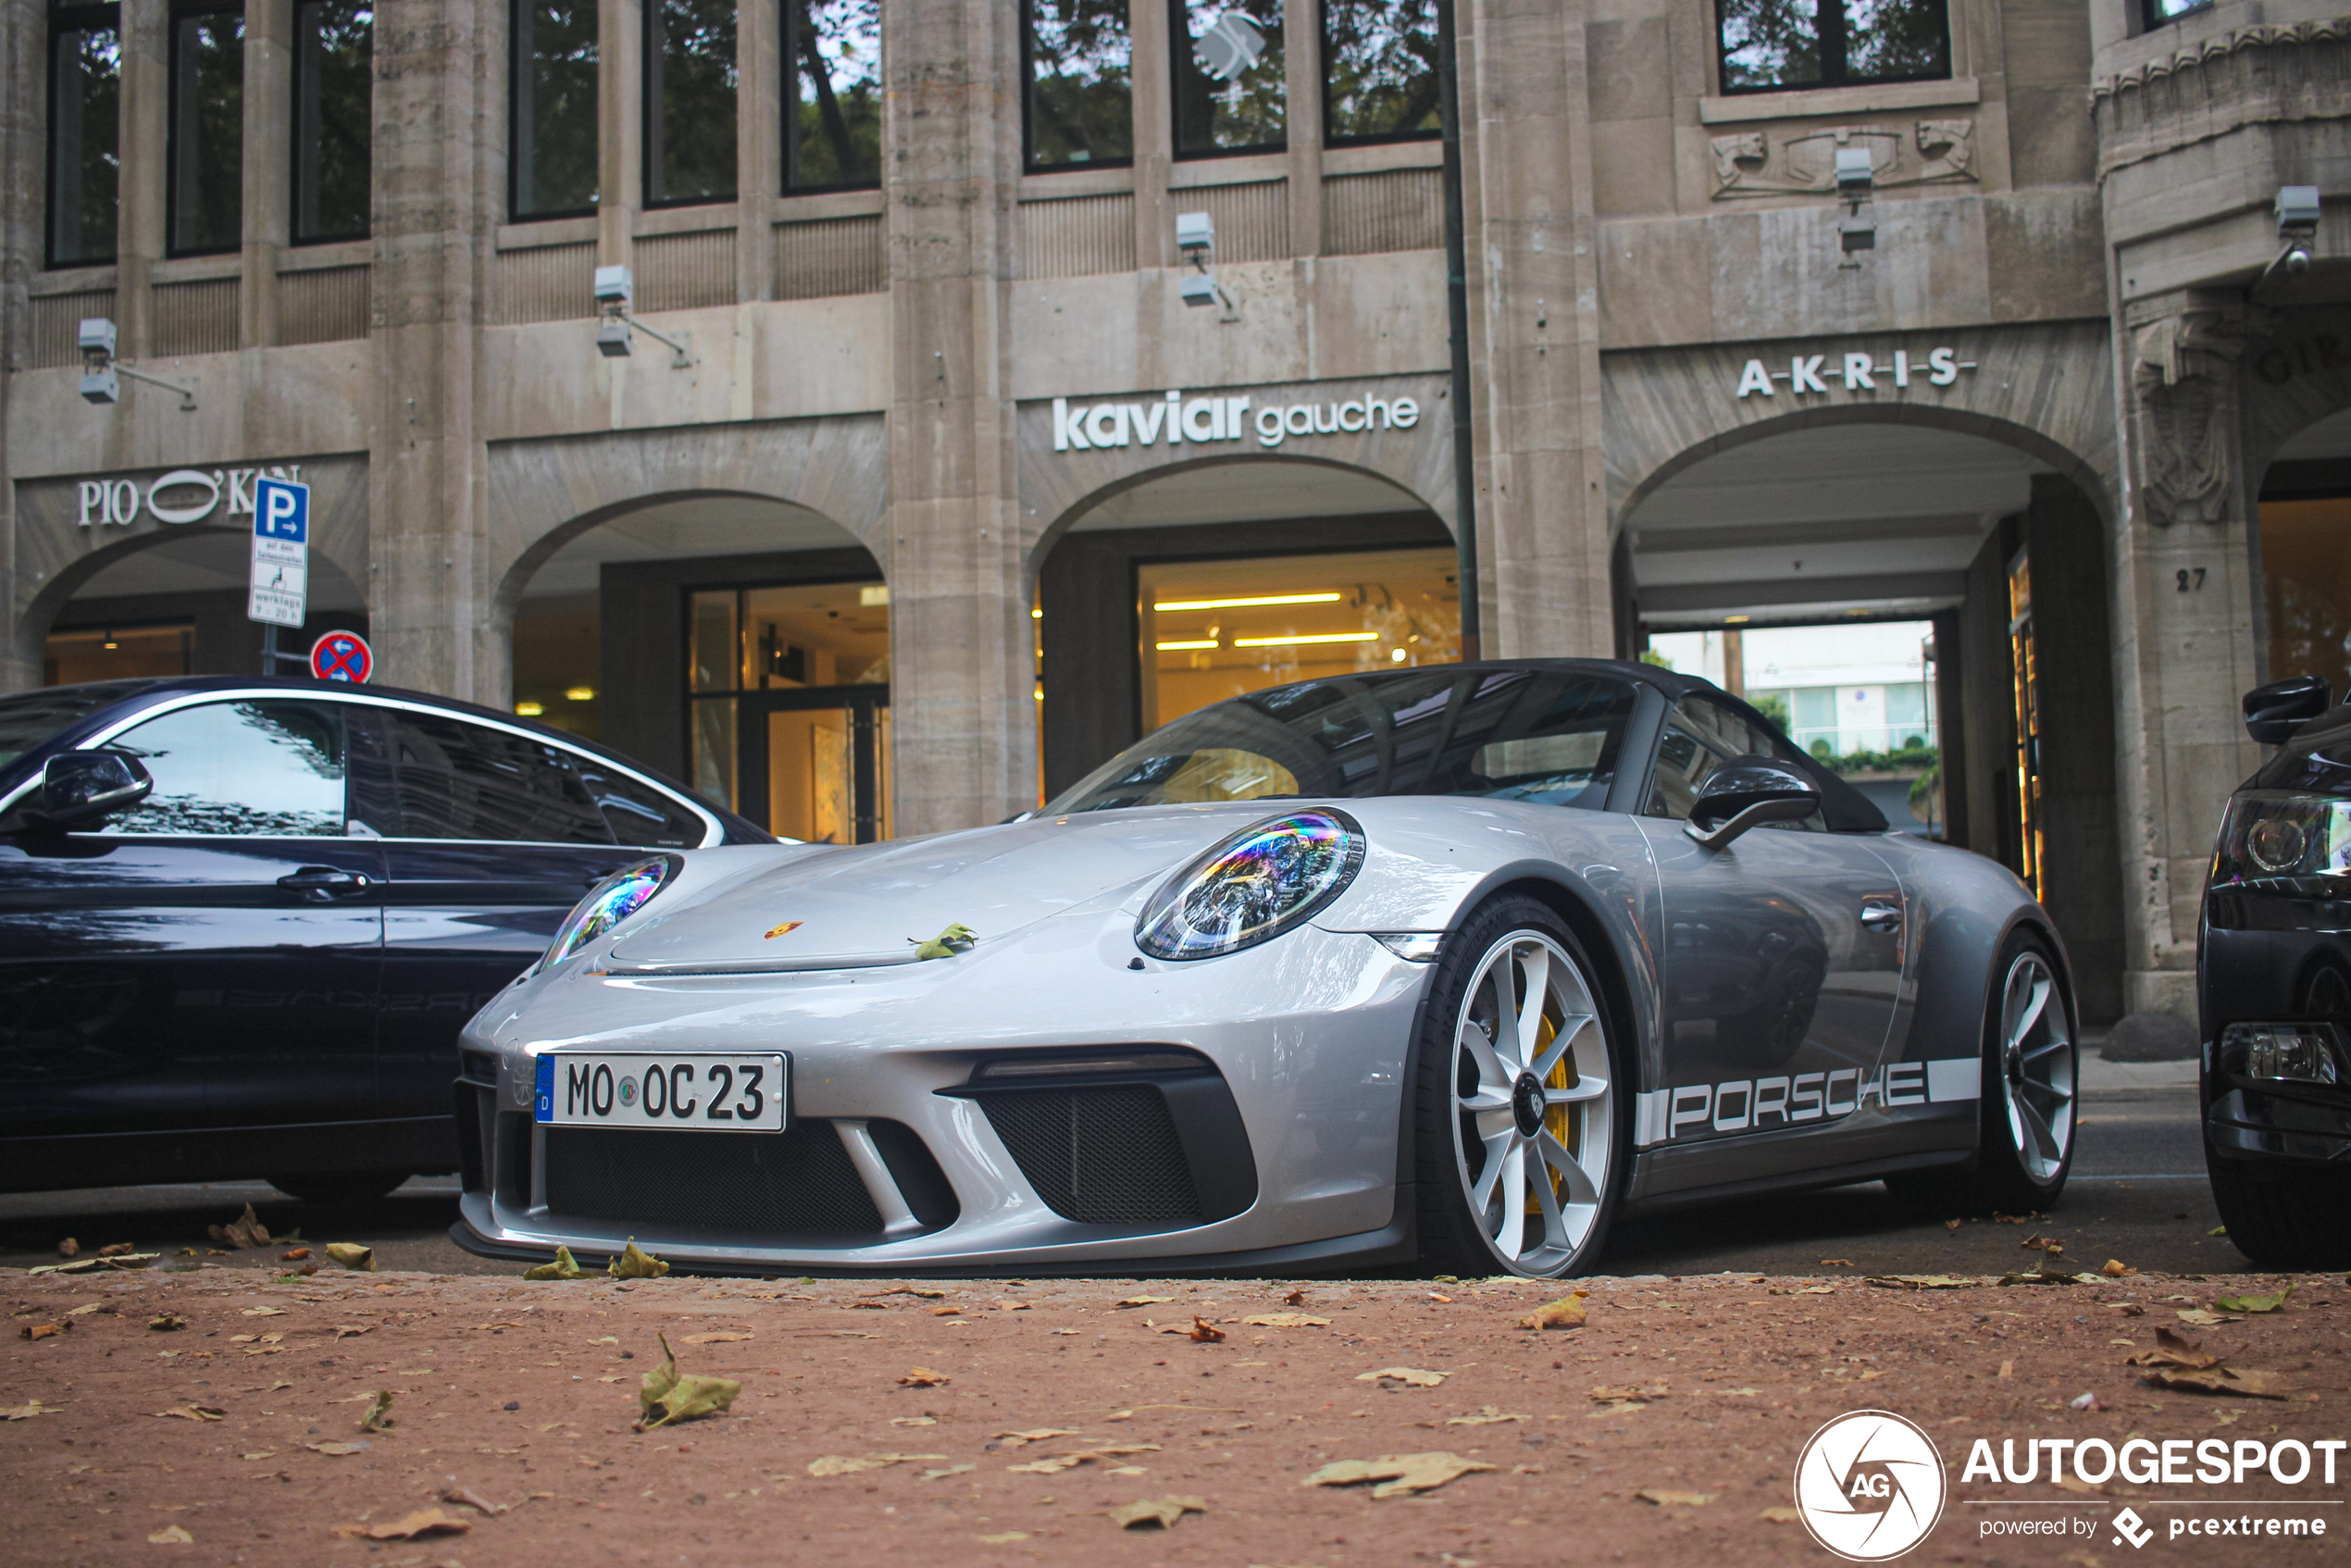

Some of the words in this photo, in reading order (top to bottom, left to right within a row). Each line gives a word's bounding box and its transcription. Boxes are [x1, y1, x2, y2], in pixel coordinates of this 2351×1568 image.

[1052, 390, 1250, 452] kaviar
[1255, 392, 1419, 447] gauche
[79, 479, 139, 526] PIO
[147, 466, 300, 524] O'K
[267, 486, 296, 533] P
[2176, 567, 2207, 592] 27
[541, 1097, 548, 1110] D
[568, 1063, 615, 1116] MO
[643, 1064, 696, 1118] OC
[707, 1064, 765, 1121] 23
[1670, 1062, 1925, 1139] PORSCHE
